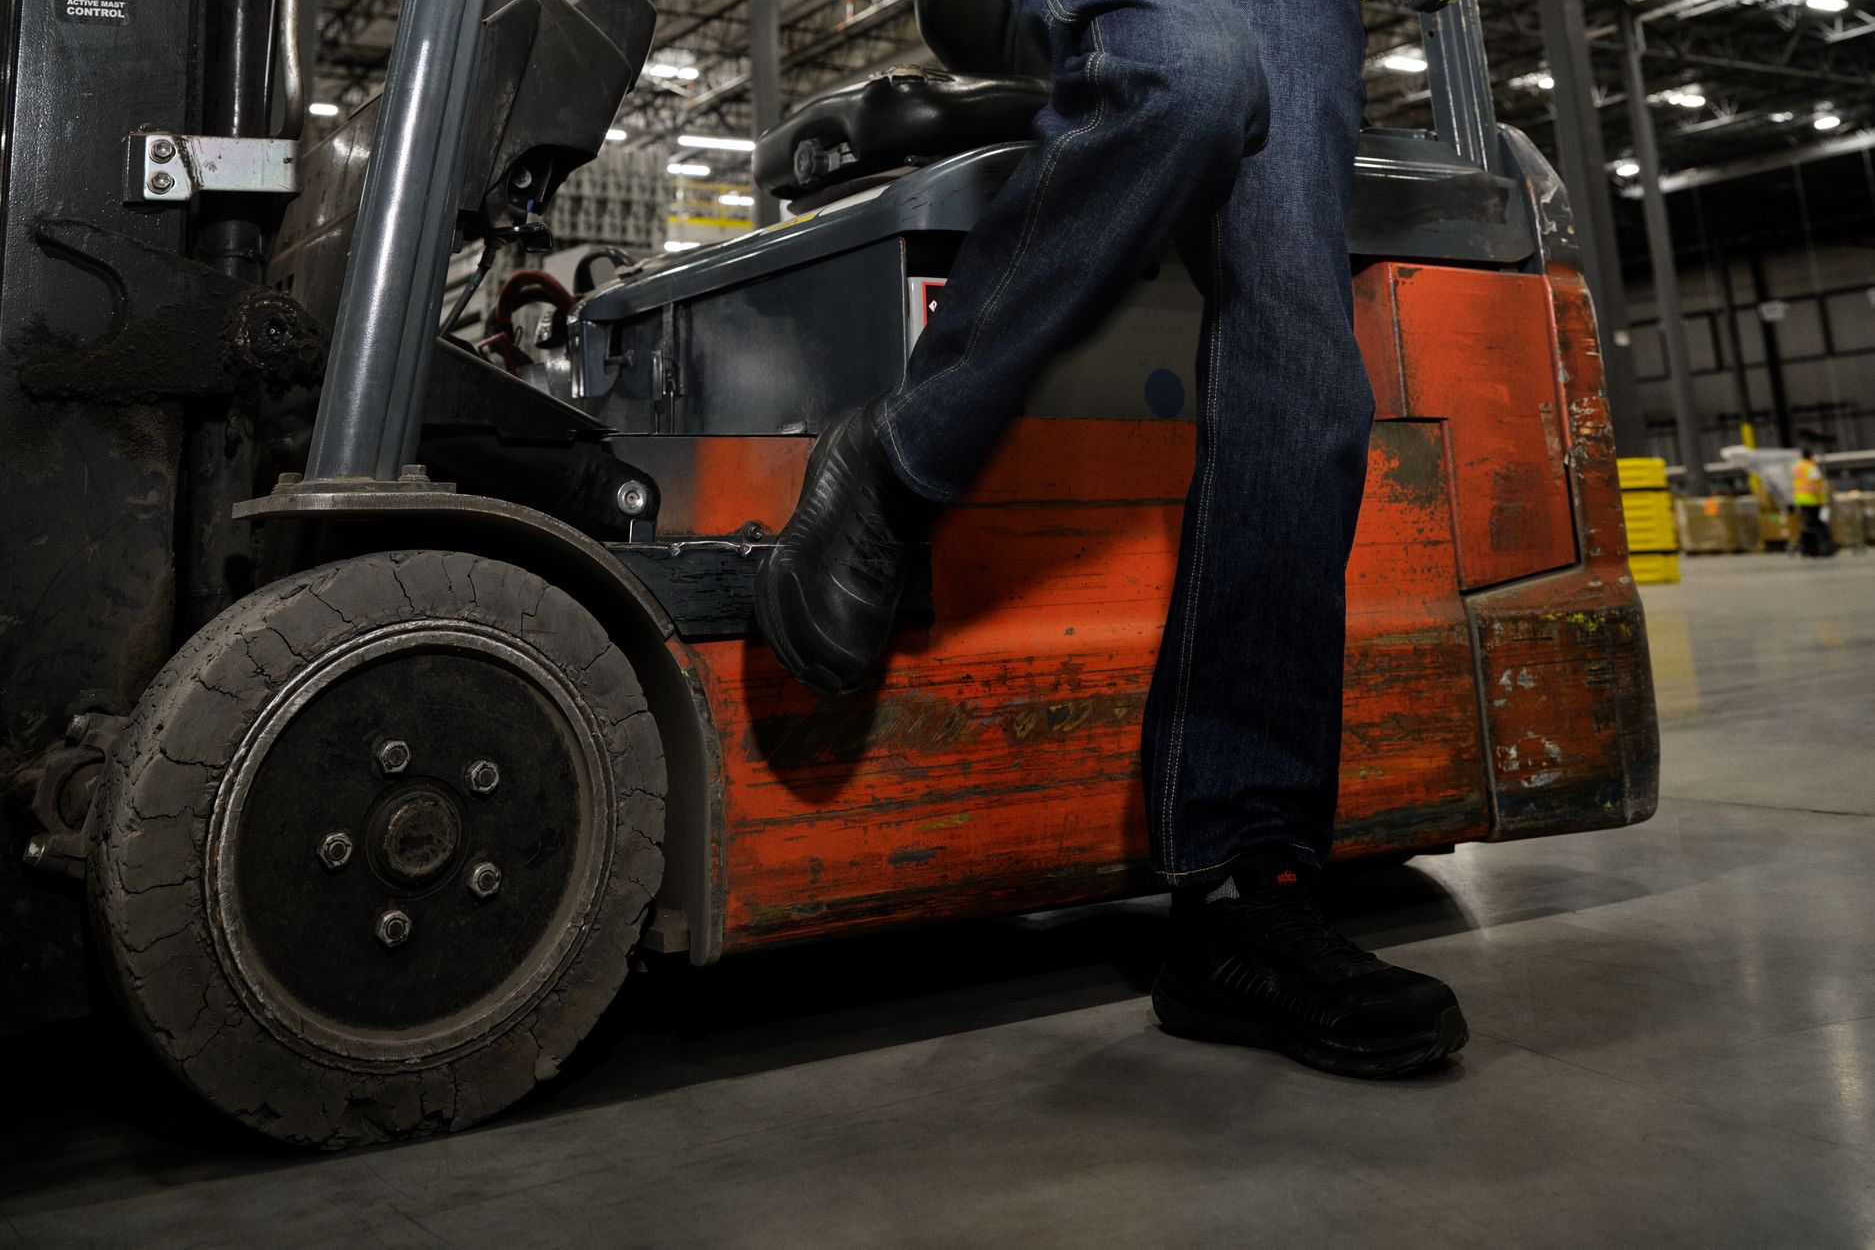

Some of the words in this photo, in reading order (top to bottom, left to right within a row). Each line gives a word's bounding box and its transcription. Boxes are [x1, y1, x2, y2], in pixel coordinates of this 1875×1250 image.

[67, 0, 99, 7] ACTIVE
[101, 0, 125, 8] MAST
[66, 7, 125, 19] CONTROL
